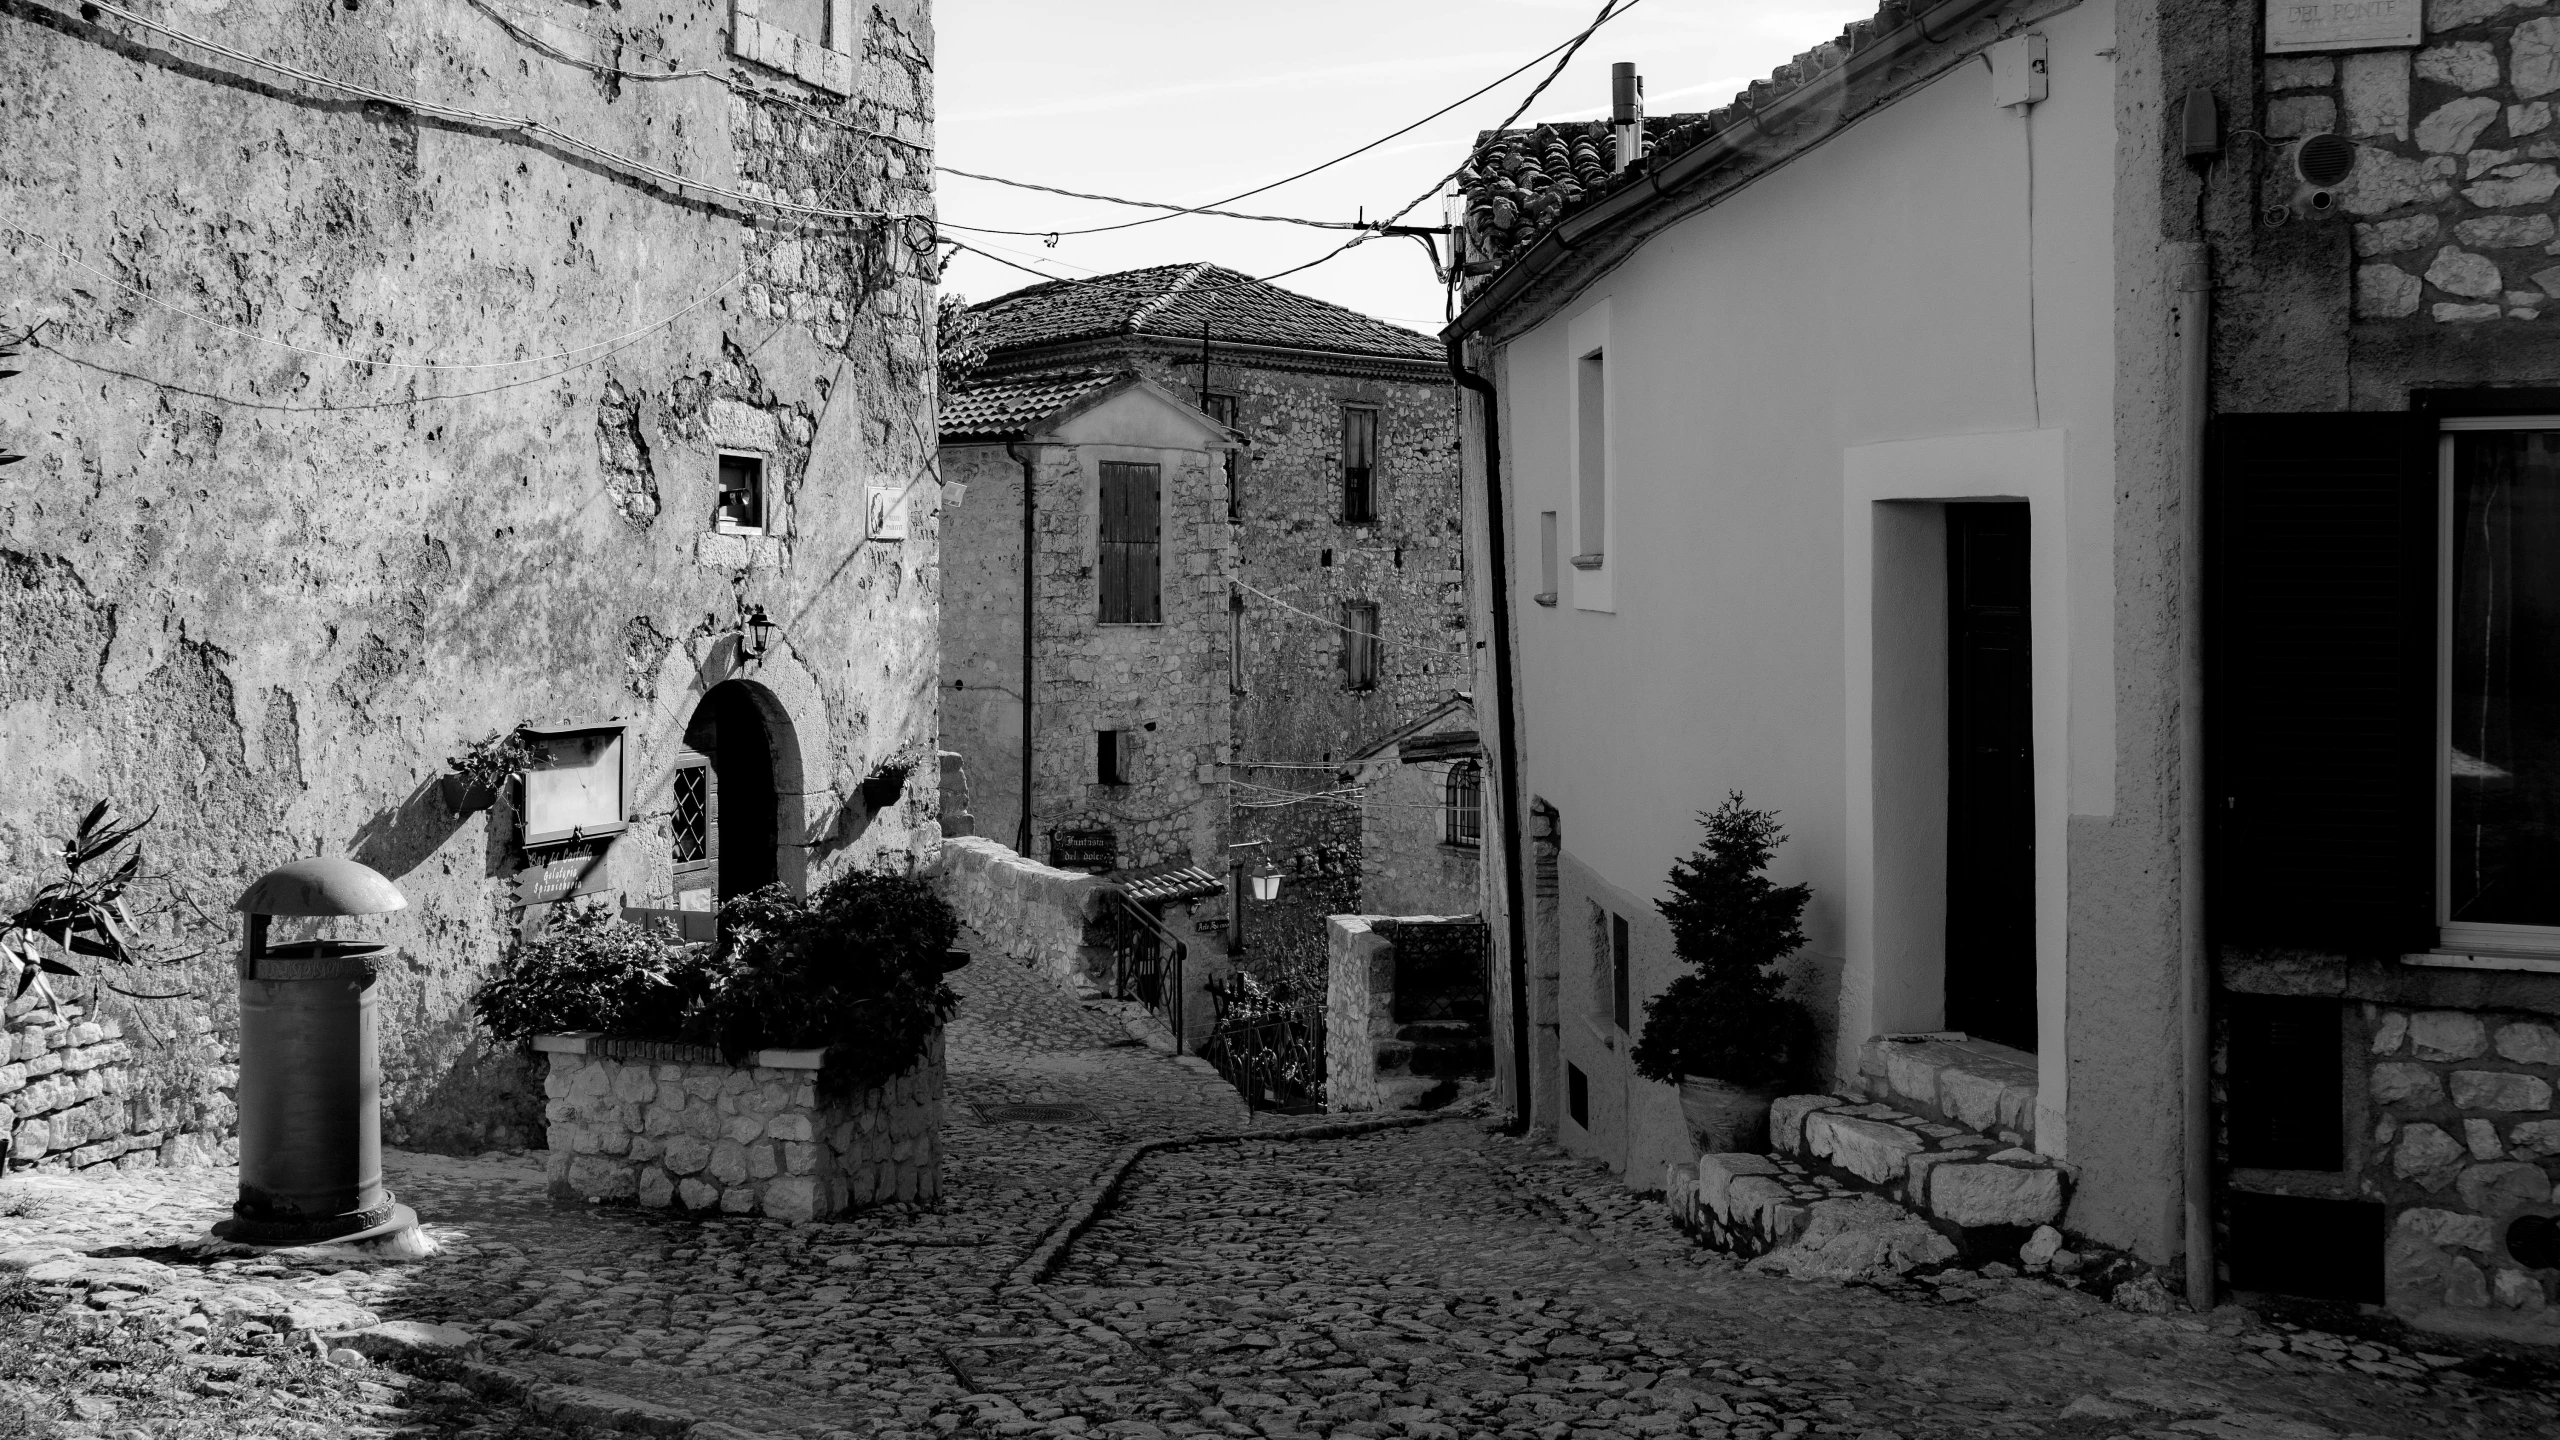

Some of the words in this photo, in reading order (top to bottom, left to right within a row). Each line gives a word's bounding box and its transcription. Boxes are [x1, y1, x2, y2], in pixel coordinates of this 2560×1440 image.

[2287, 6, 2325, 23] DEL
[2333, 1, 2397, 20] PONTE
[1065, 835, 1104, 847] Fantasia
[529, 852, 547, 868] Bar
[547, 851, 560, 866] del
[563, 843, 593, 864] Castello
[1064, 850, 1077, 861] del
[1083, 850, 1104, 861] dolce
